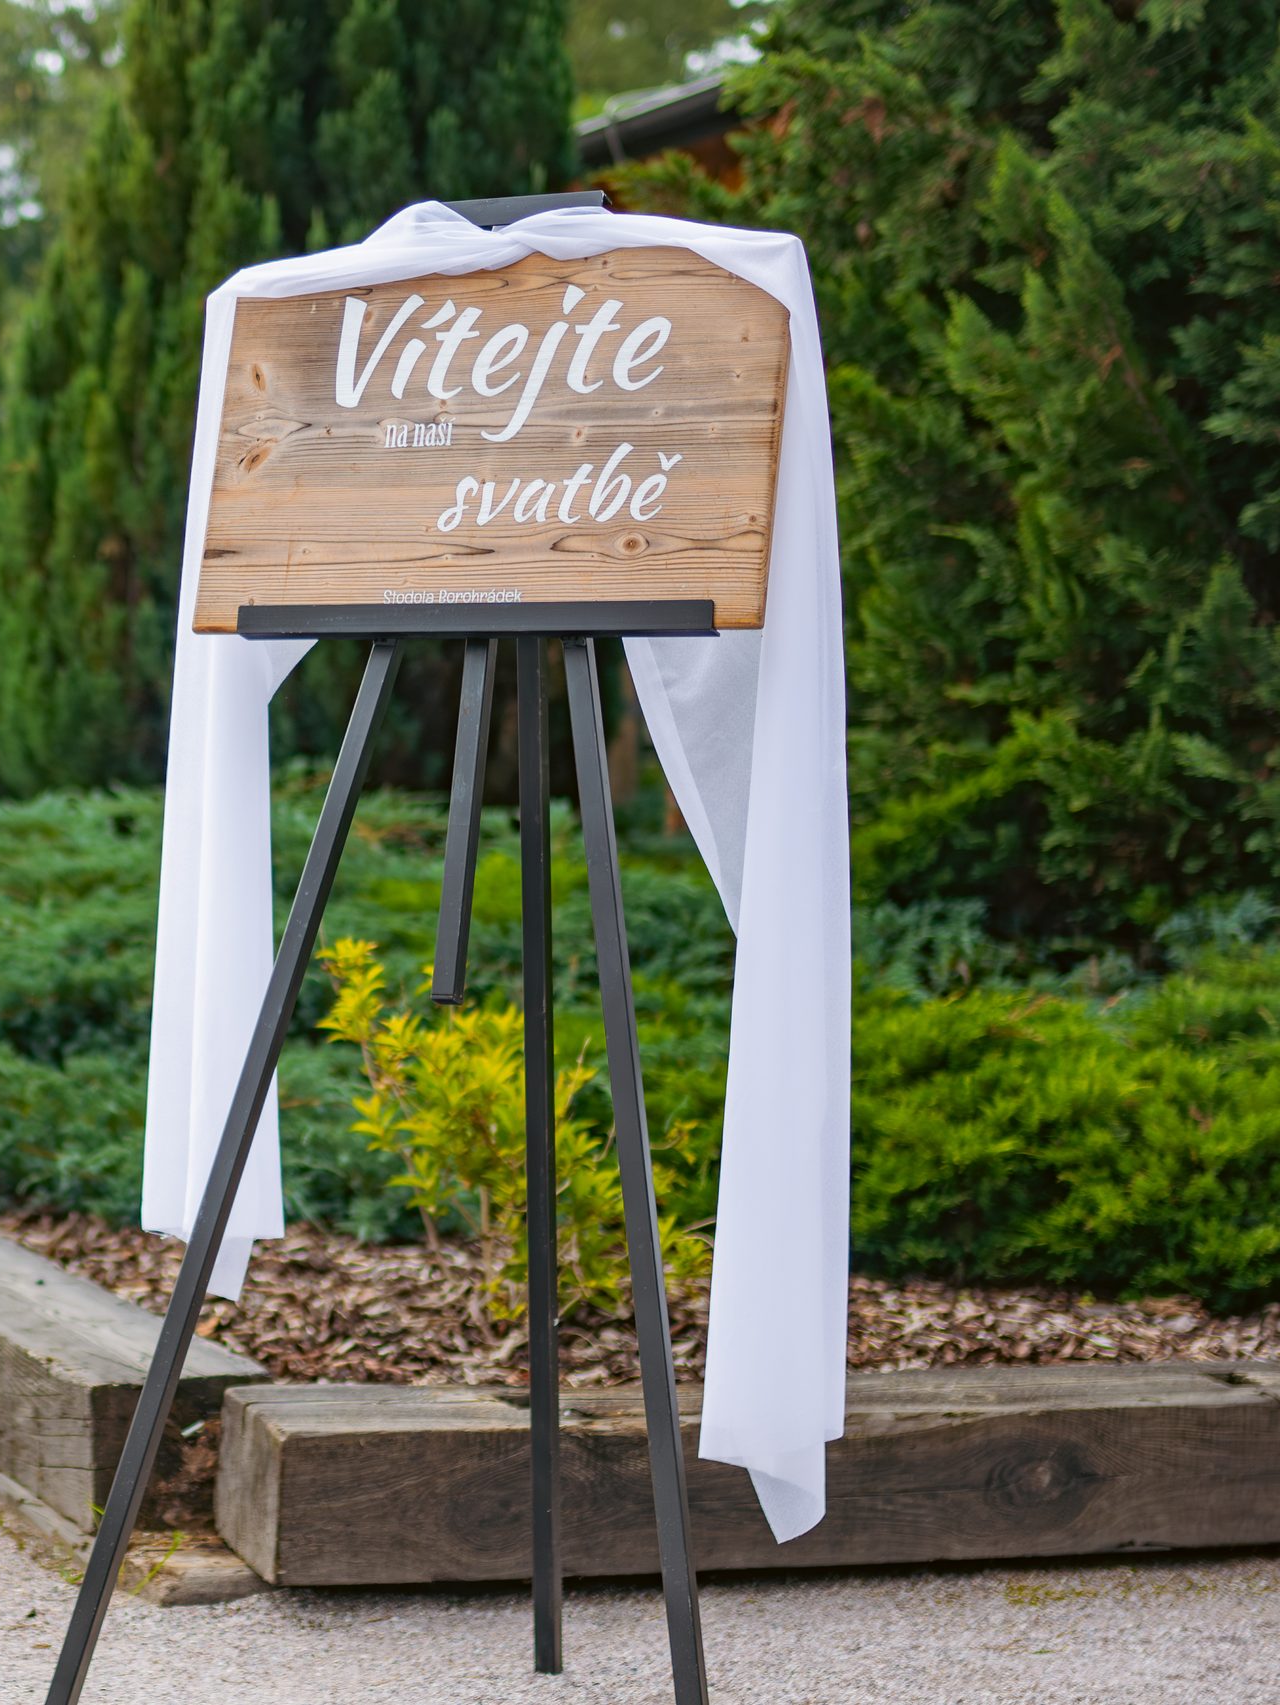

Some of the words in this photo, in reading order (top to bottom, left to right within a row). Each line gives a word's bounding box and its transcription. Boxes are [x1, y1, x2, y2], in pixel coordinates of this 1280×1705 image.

[335, 285, 672, 442] Vítejte
[384, 424, 408, 448] na
[412, 416, 457, 448] naší
[436, 442, 683, 532] svatbě
[383, 589, 434, 604] Stodola
[438, 588, 522, 604] Borohrádek
